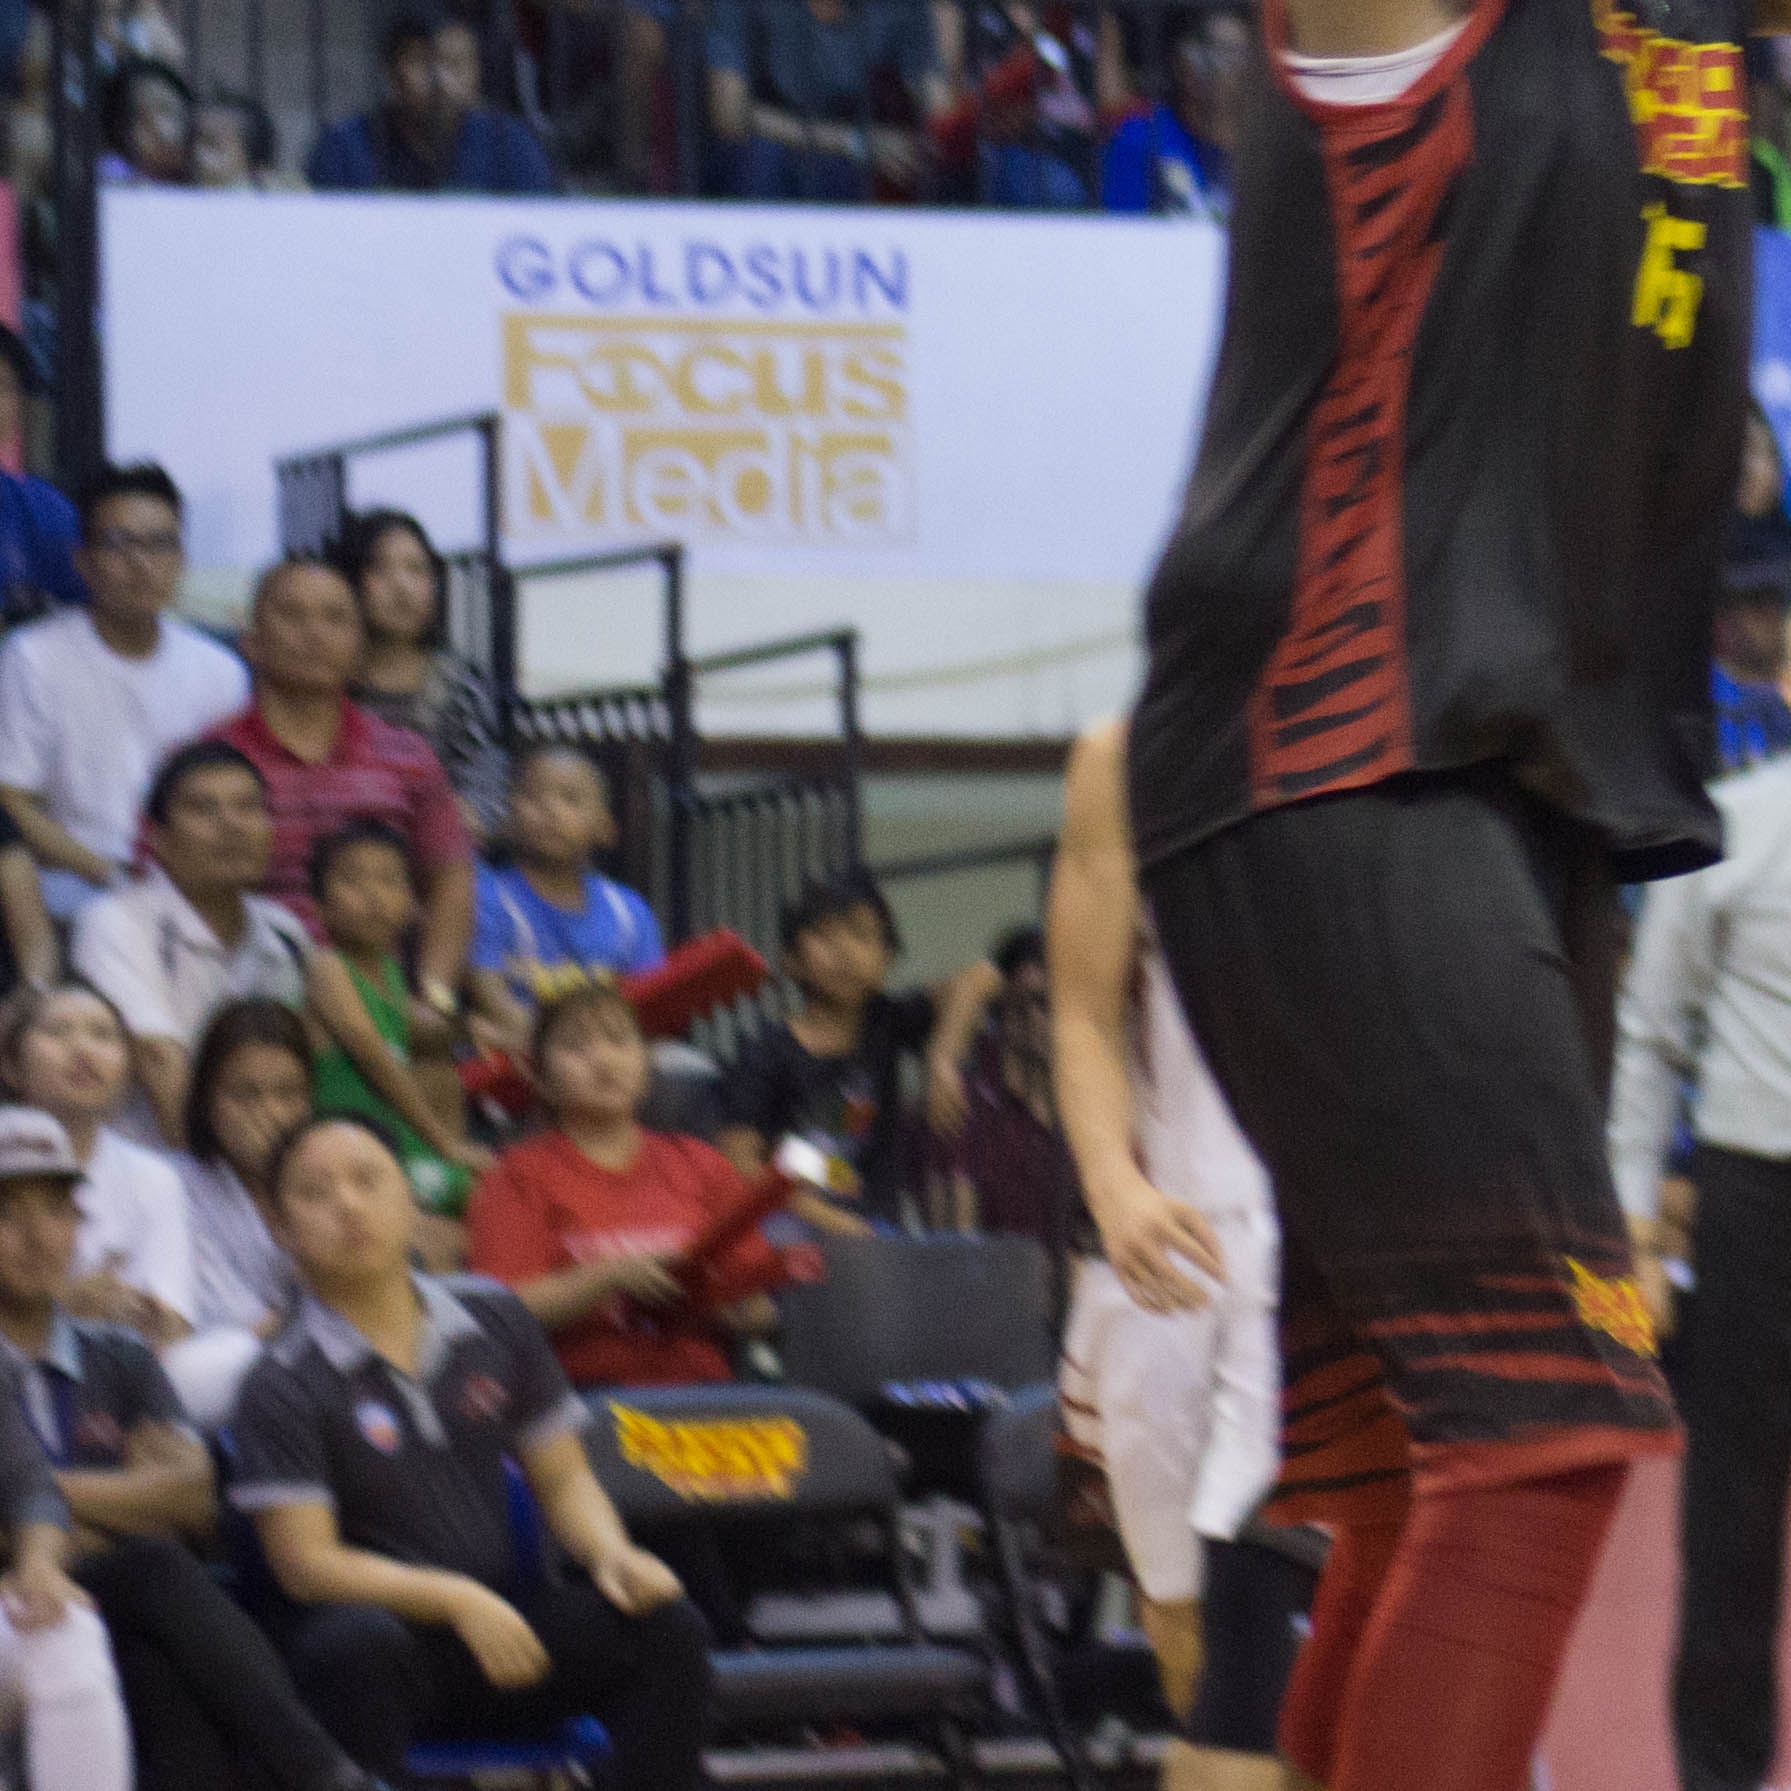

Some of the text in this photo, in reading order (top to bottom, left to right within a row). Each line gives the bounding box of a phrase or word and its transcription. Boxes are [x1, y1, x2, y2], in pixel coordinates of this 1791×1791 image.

[494, 236, 910, 310] GOLDSUN
[505, 315, 906, 422] Focus
[502, 414, 906, 534] Media
